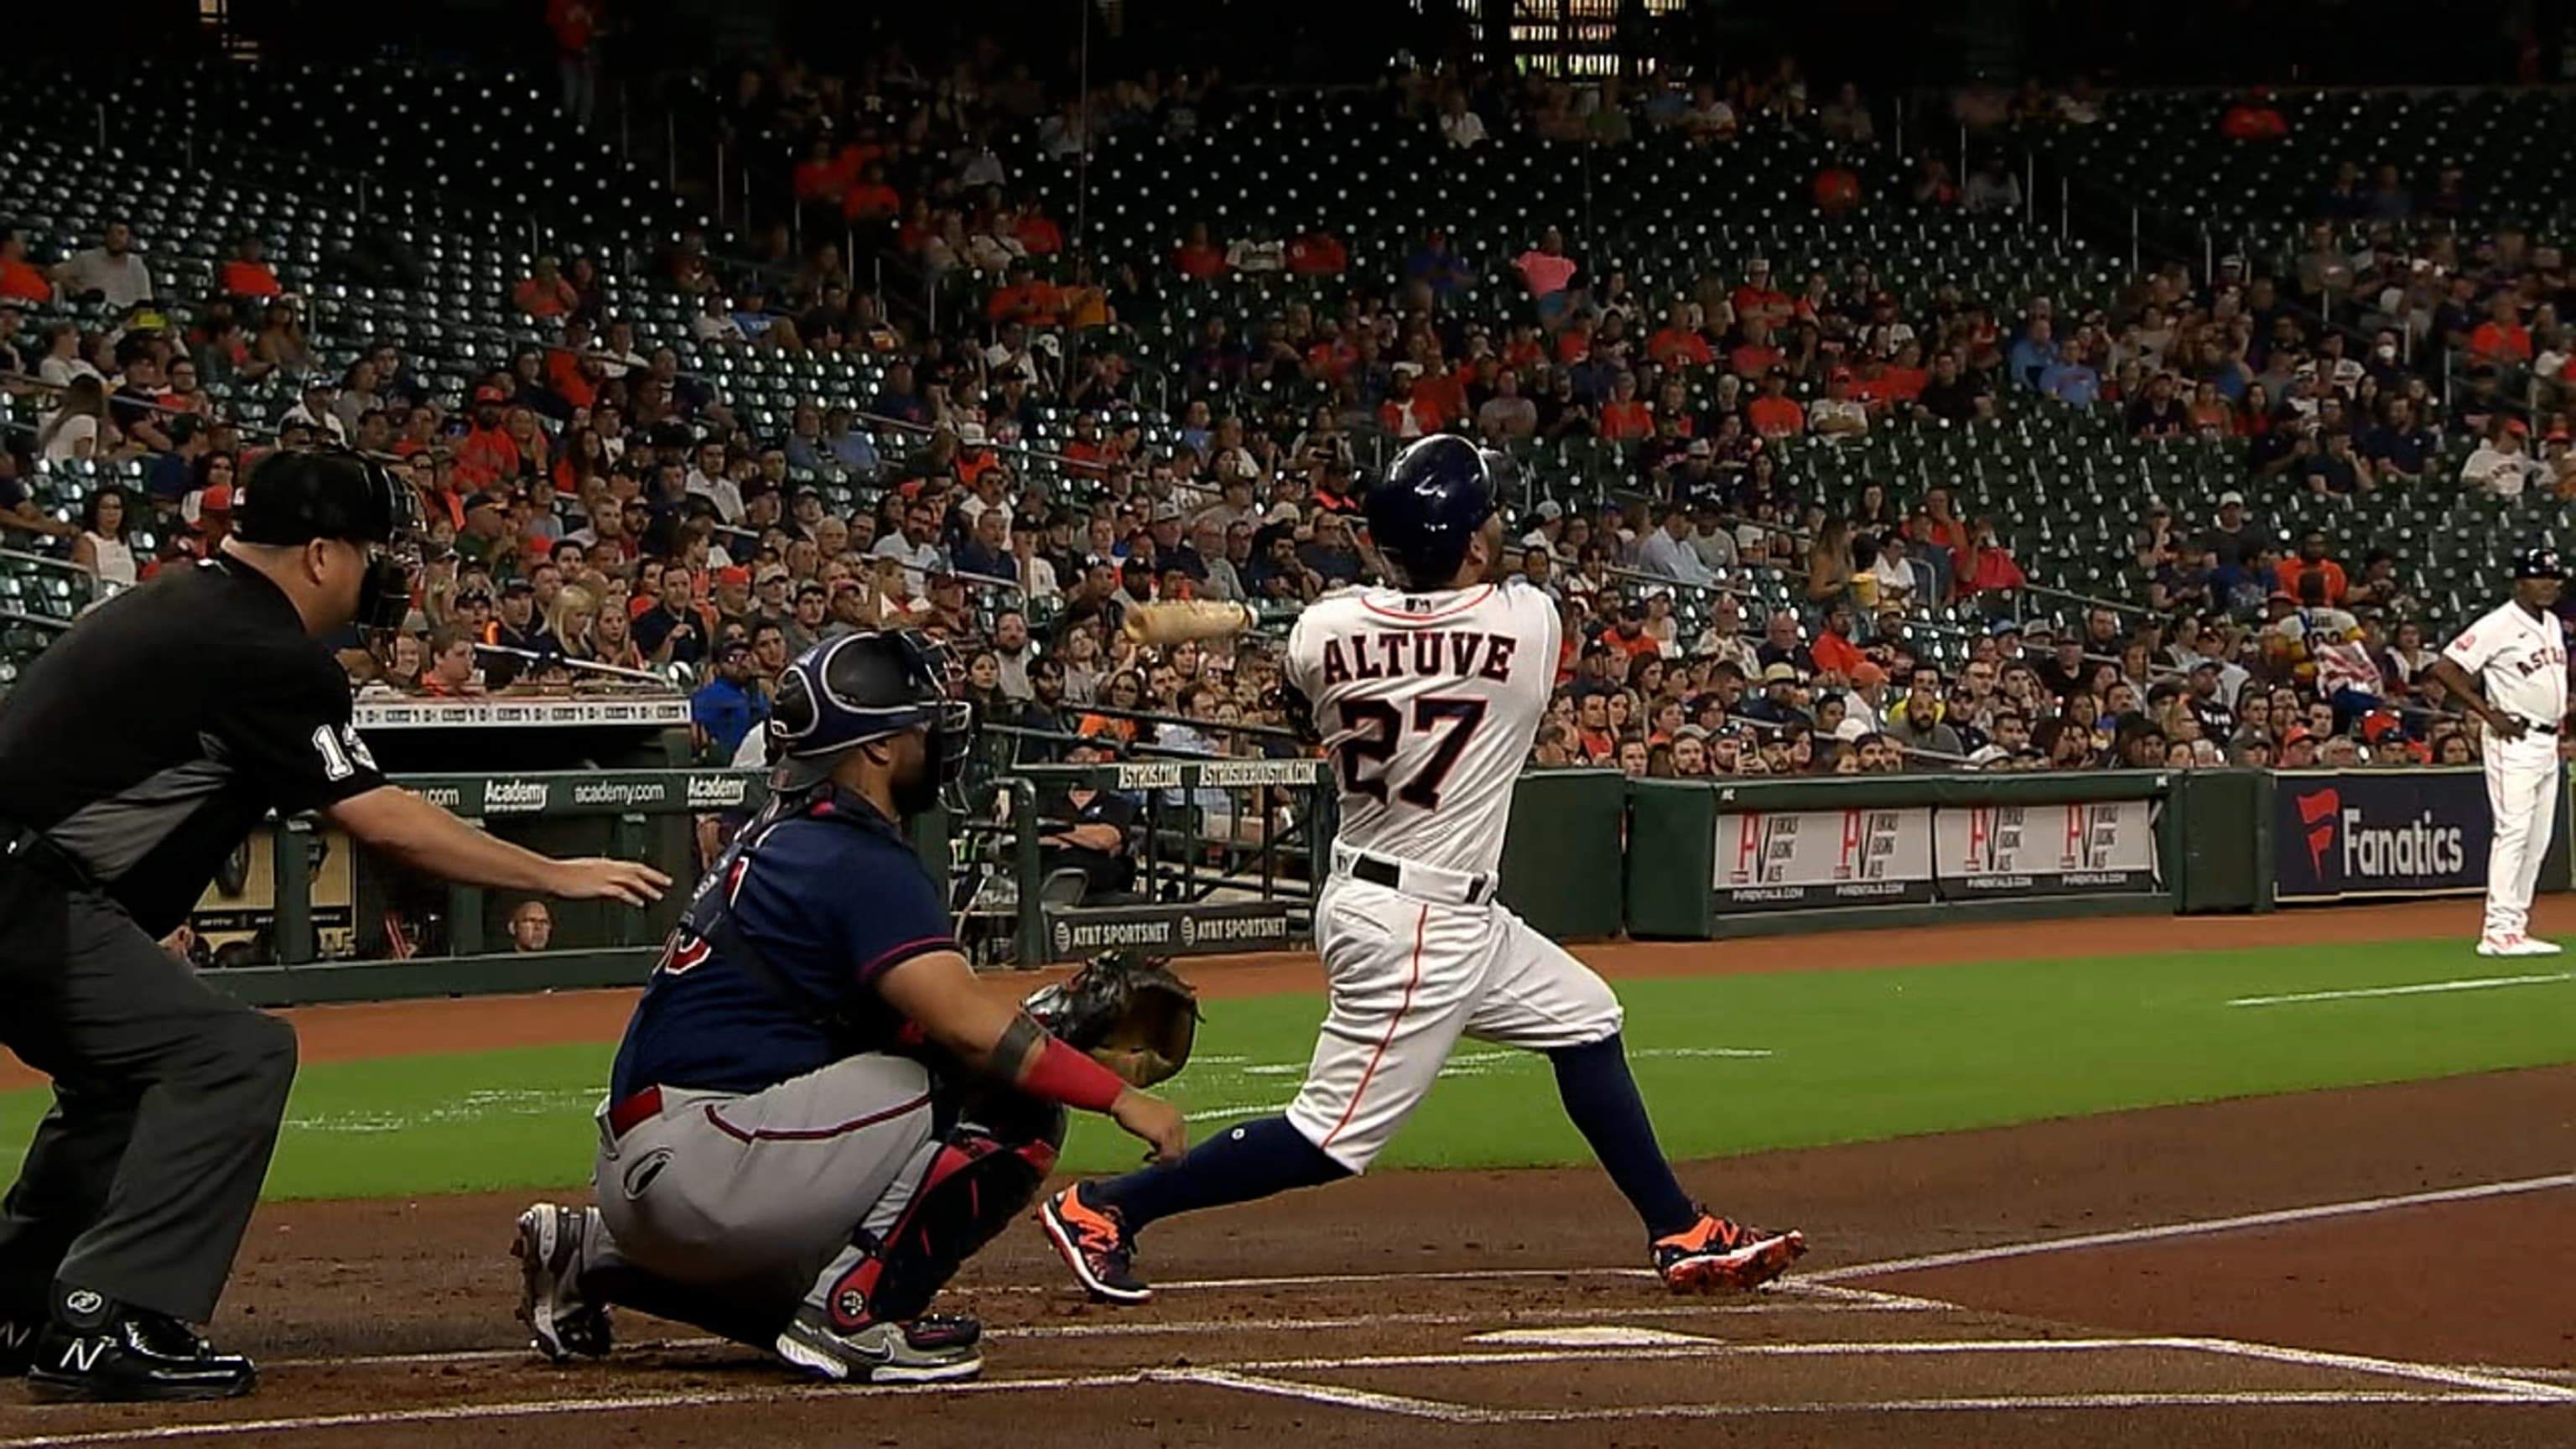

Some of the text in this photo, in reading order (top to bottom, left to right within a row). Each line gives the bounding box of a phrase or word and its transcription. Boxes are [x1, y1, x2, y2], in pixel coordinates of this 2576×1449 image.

[1323, 631, 1516, 684] ALTUVE
[1339, 696, 1489, 813] 27
[574, 779, 665, 805] academy.com
[688, 774, 748, 805] Academy
[1119, 764, 1182, 789] ASTROS.COM
[485, 779, 549, 811] Academy
[2344, 808, 2464, 877] Fanatics
[1072, 922, 1170, 947] AT&T SPORTSNET
[1197, 917, 1287, 940] AT&T SPORTSNET
